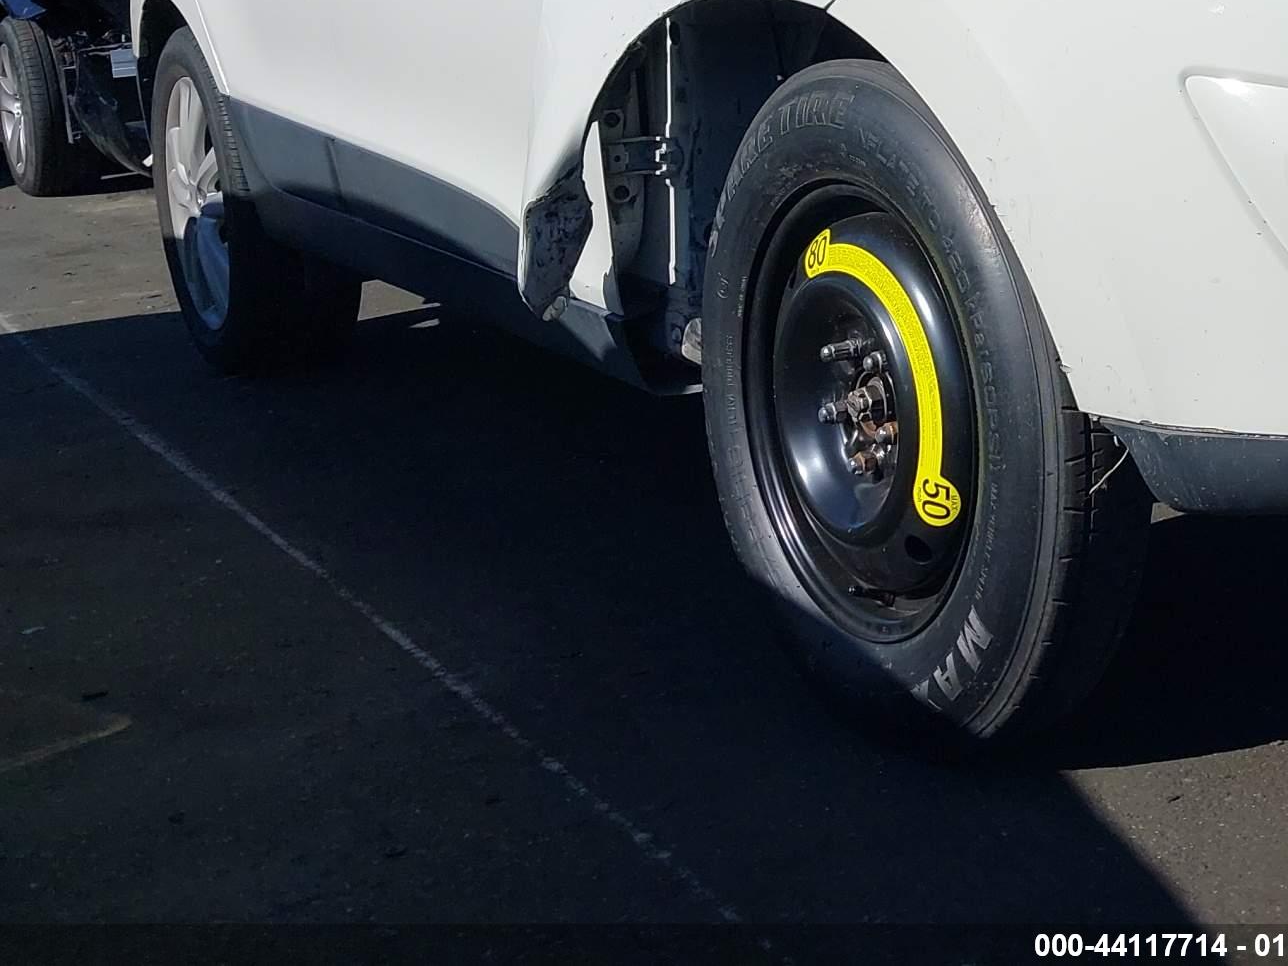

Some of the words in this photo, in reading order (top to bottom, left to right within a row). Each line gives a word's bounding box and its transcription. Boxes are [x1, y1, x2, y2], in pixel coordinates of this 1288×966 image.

[778, 91, 855, 136] TIRE
[808, 236, 827, 269] 80
[922, 478, 950, 520] 50
